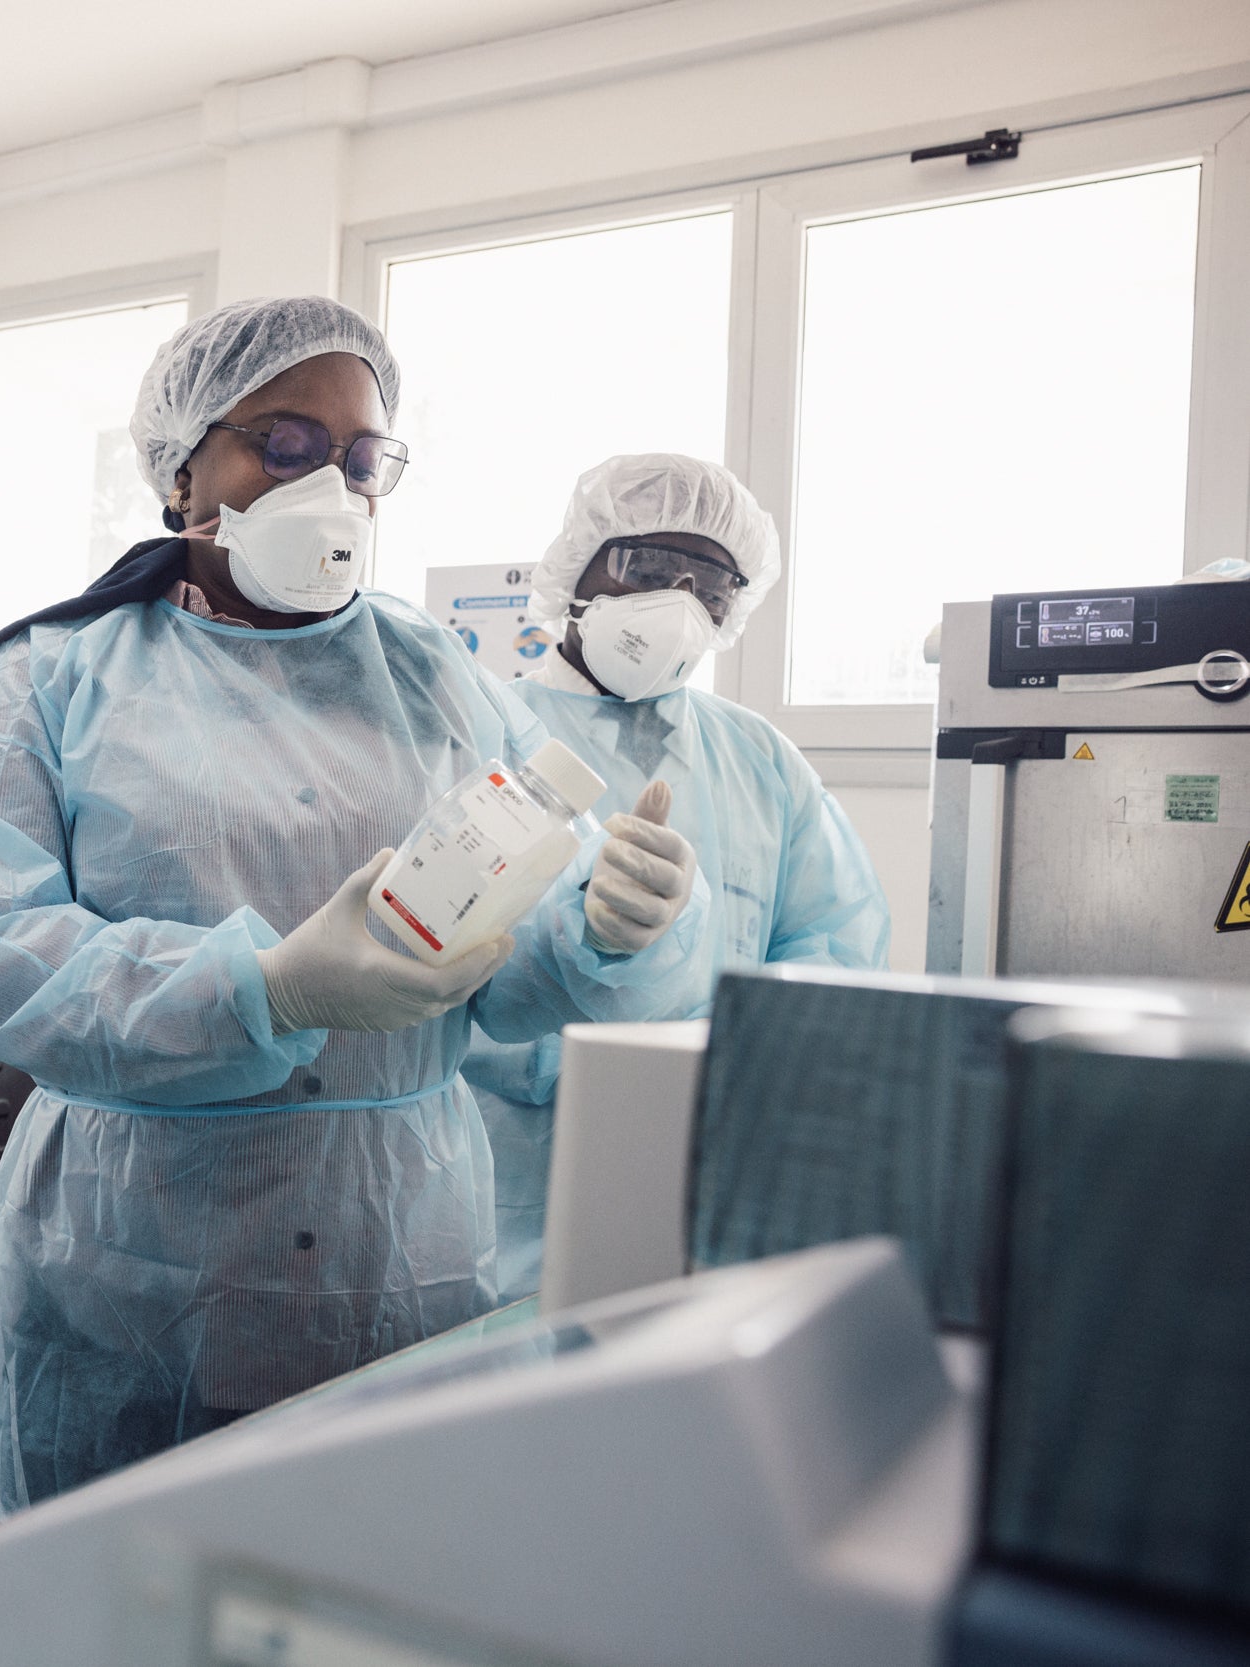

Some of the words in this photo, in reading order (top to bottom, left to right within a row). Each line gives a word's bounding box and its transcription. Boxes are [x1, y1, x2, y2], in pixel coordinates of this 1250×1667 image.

[331, 549, 352, 562] 3M
[458, 598, 510, 610] Comment
[1104, 628, 1124, 638] 100
